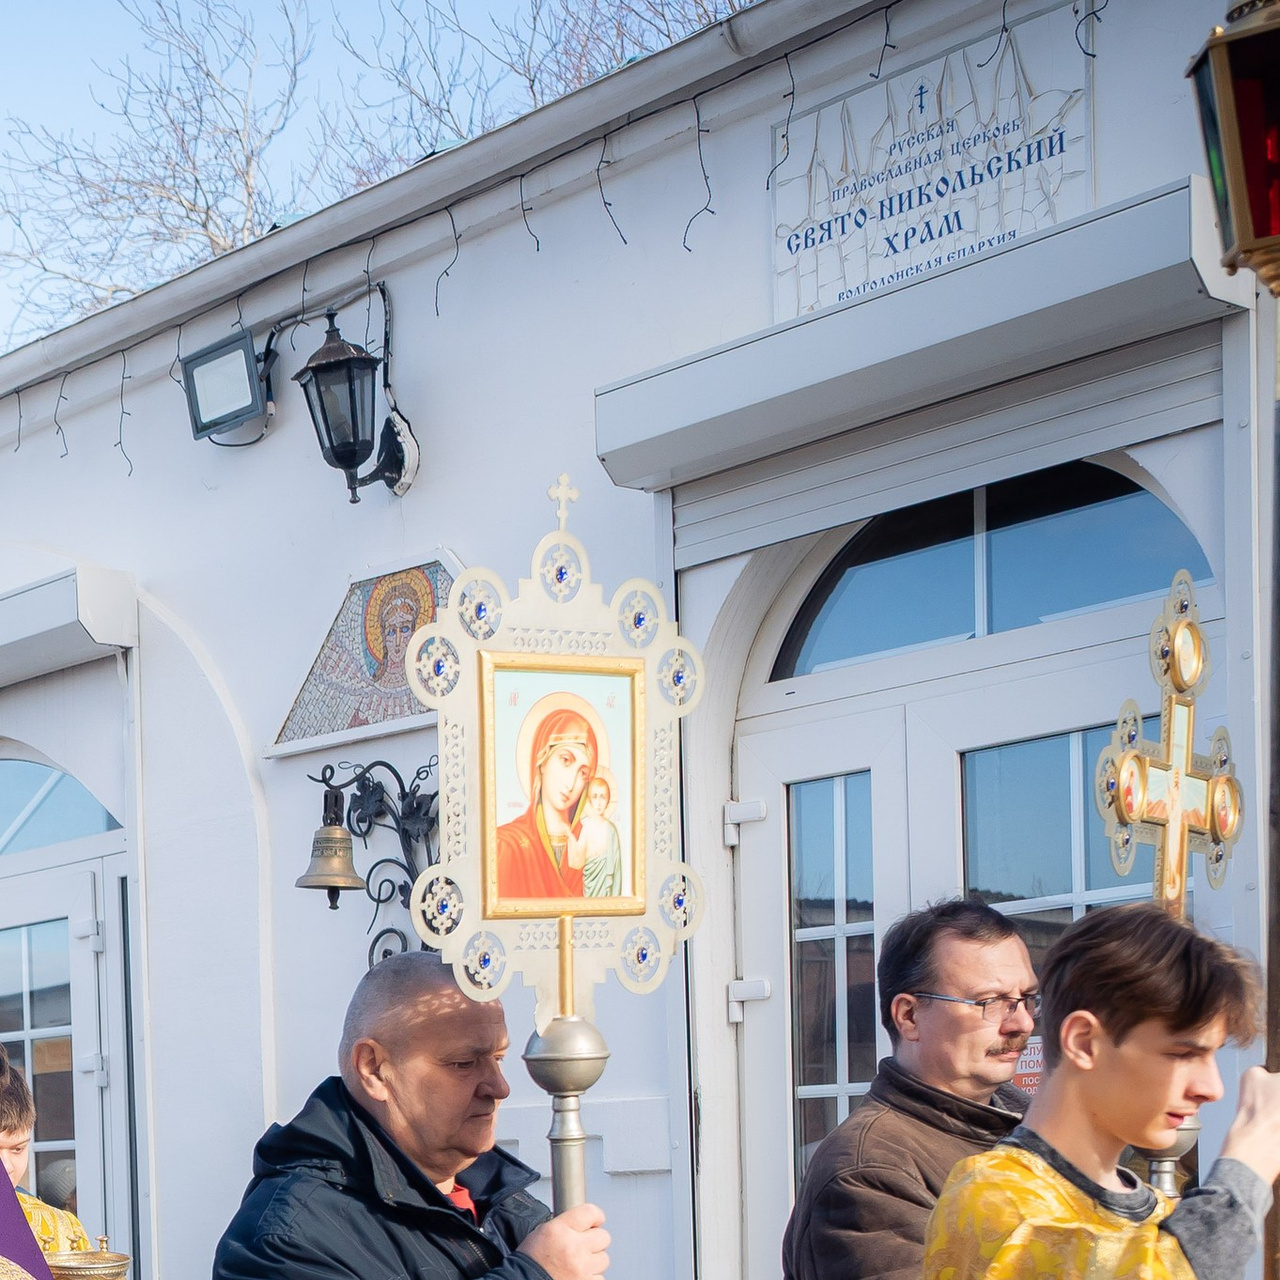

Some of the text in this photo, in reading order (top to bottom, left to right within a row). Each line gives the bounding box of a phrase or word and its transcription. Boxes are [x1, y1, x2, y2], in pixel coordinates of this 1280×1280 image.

[831, 119, 1021, 203] ПРАВОСЛАВНАЯ ЦЕРКОВЬ
[889, 119, 955, 156] РУССКАЯ
[786, 125, 1067, 255] СВЯТО-НИКОЛЬСКИЙ
[883, 209, 964, 259] ХРАМ
[947, 229, 1018, 263] ЕПАРХИЯ
